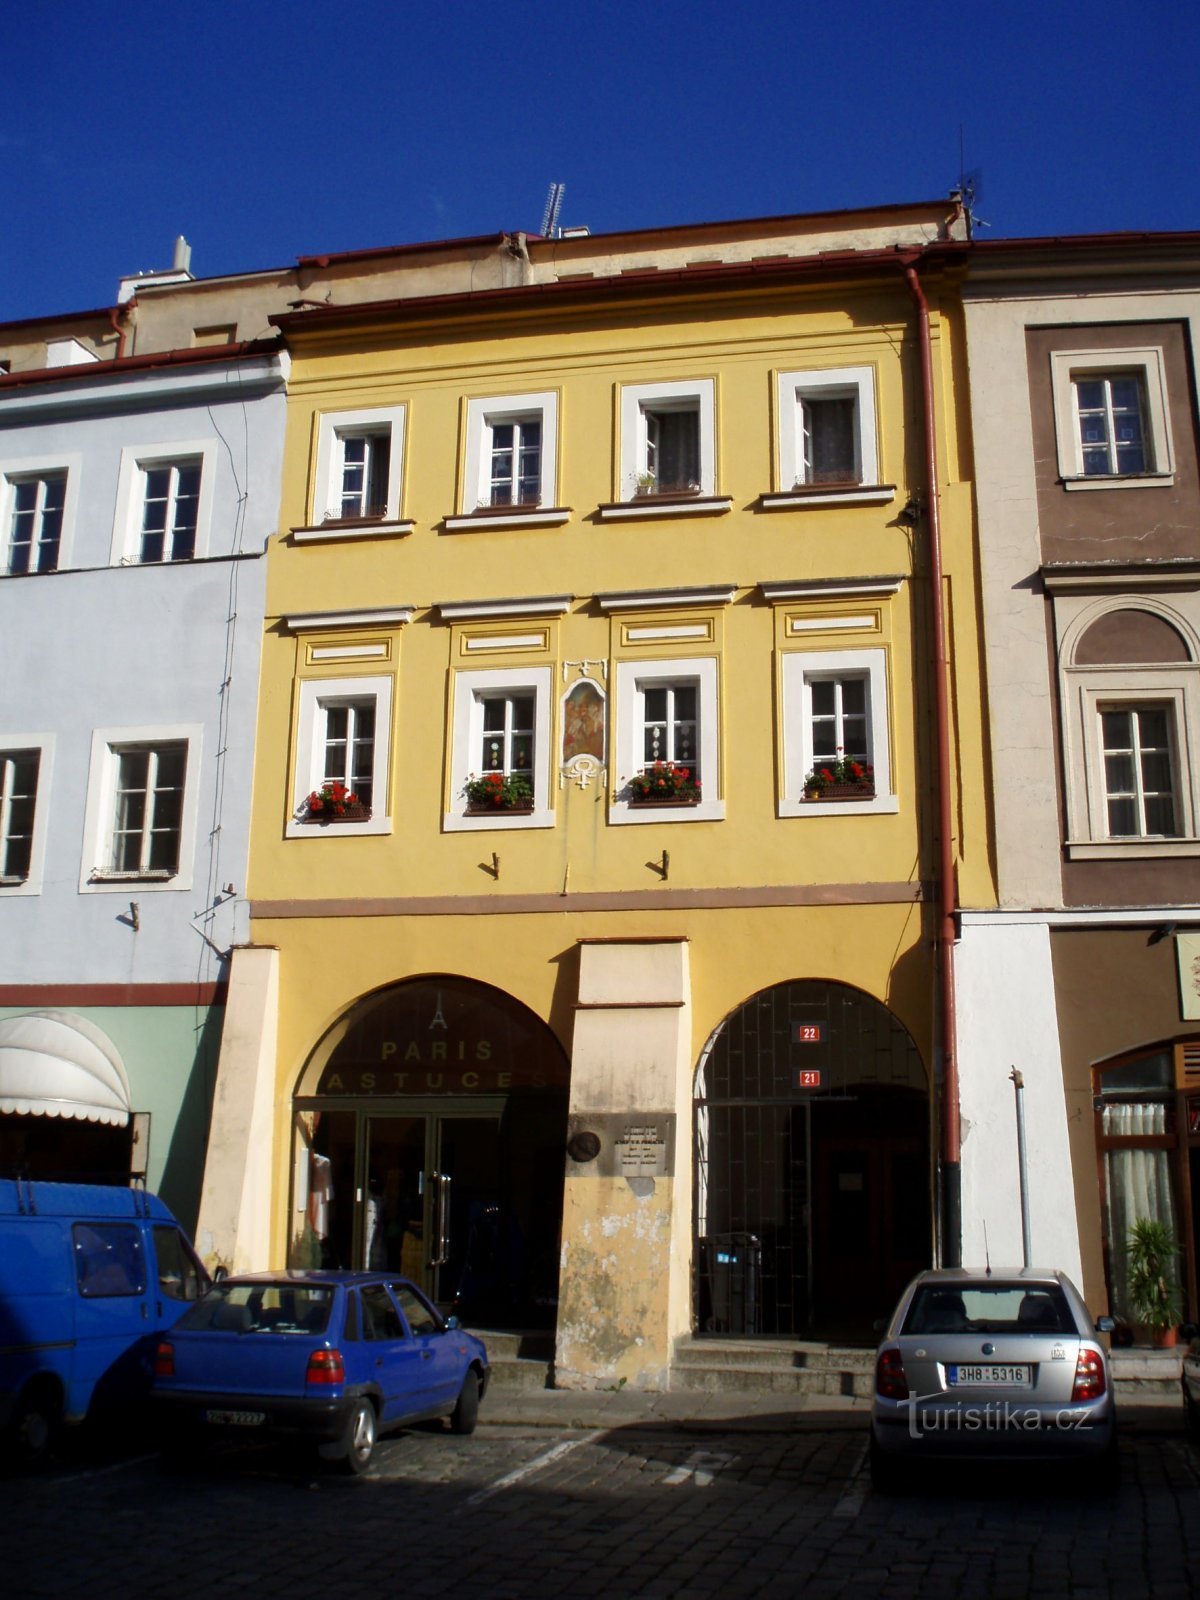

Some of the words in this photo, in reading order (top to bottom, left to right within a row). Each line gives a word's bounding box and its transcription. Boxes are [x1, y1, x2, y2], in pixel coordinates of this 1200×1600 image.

[803, 1028, 816, 1039] 22
[381, 1041, 492, 1060] PARIS
[804, 1073, 815, 1084] 21
[992, 1368, 1023, 1381] 5316
